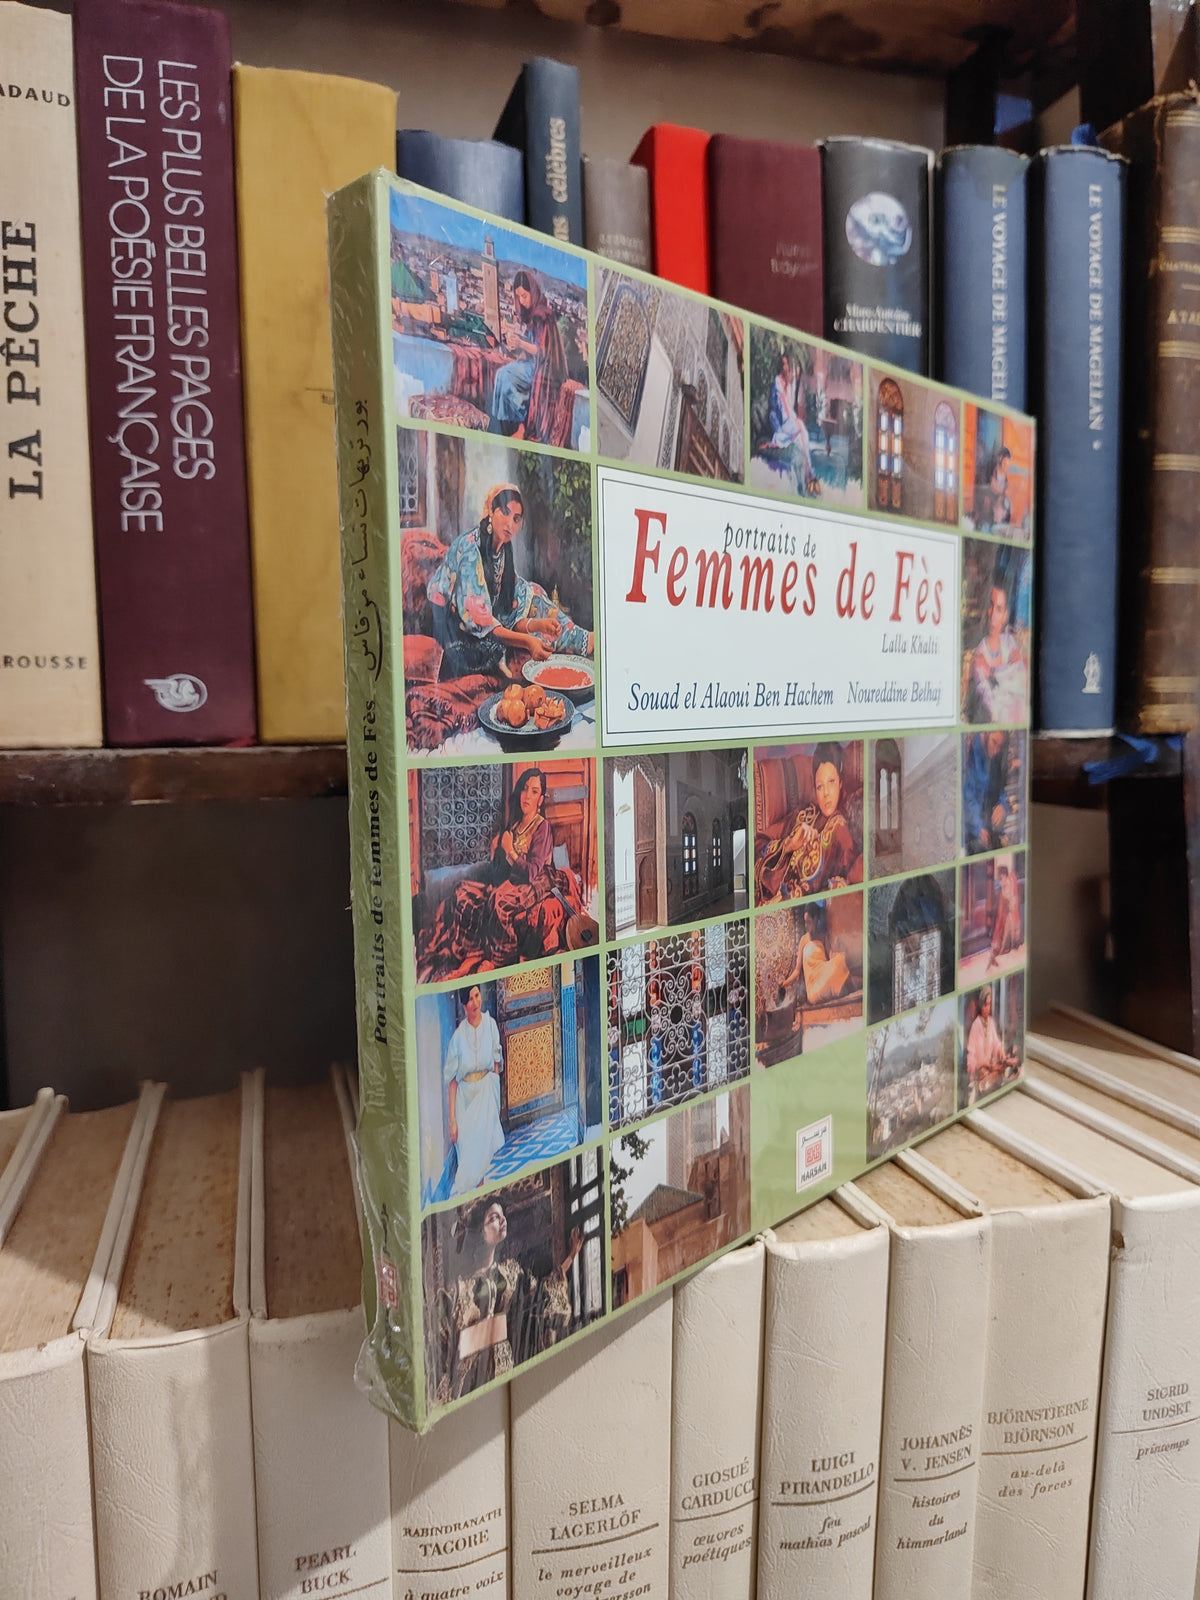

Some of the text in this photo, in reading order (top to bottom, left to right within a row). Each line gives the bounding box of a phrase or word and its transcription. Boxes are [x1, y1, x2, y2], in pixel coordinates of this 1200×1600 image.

[992, 184, 1007, 209] LE
[992, 212, 1008, 290] VOYAGE
[158, 60, 216, 480] LES PLUS BELLES PAGES
[103, 55, 164, 532] DE LA POÉSIE FRANÇAISE
[992, 295, 1008, 321] DE
[1089, 184, 1104, 431] LE VOYAGE DE MAGELLAN
[1, 220, 43, 500] LA PÊCHE
[722, 522, 817, 559] portraits de
[625, 508, 944, 626] Femmes de Fès
[882, 633, 907, 654] Lalla
[0, 655, 88, 670] ROUSSE
[628, 681, 942, 711] Souad el Alaoui Ben Hachem Noureddine Belhaj
[363, 700, 377, 743] Fès
[364, 751, 378, 782] de
[372, 895, 384, 927] de
[373, 932, 387, 1046] Portraits
[1146, 1382, 1189, 1402] SIGRID
[986, 1398, 1089, 1426] BJÖRNSTJERNE
[1142, 1401, 1191, 1422] UNDSET
[1003, 1422, 1075, 1446] BJÖRNSON
[810, 1452, 856, 1473] LUIGI
[901, 1443, 972, 1471] V. JENSEN
[1135, 1438, 1190, 1461] printemps
[692, 1456, 750, 1489] GIOSUÉ
[779, 1462, 874, 1496] PIRANDELLO
[1010, 1460, 1066, 1480] au-delà
[681, 1477, 756, 1511] CARDUCCI
[912, 1488, 961, 1509] histoires
[998, 1478, 1072, 1500] des forces
[568, 1493, 624, 1518] SELMA
[402, 1507, 502, 1538] RABINDRANATH
[550, 1508, 642, 1542] LAGERLÖF
[693, 1522, 745, 1548] œuvres
[779, 1516, 872, 1551] mathias pascal
[818, 1516, 842, 1536] feu
[928, 1514, 944, 1527] du
[419, 1529, 490, 1558] TAGORE
[896, 1521, 967, 1551] himmerland
[294, 1545, 358, 1573] PEARL
[538, 1548, 652, 1583] le merveilleux
[681, 1536, 753, 1569] poétiques
[300, 1569, 352, 1594] BUCK
[475, 1571, 504, 1590] voix
[556, 1570, 636, 1600] voyage de
